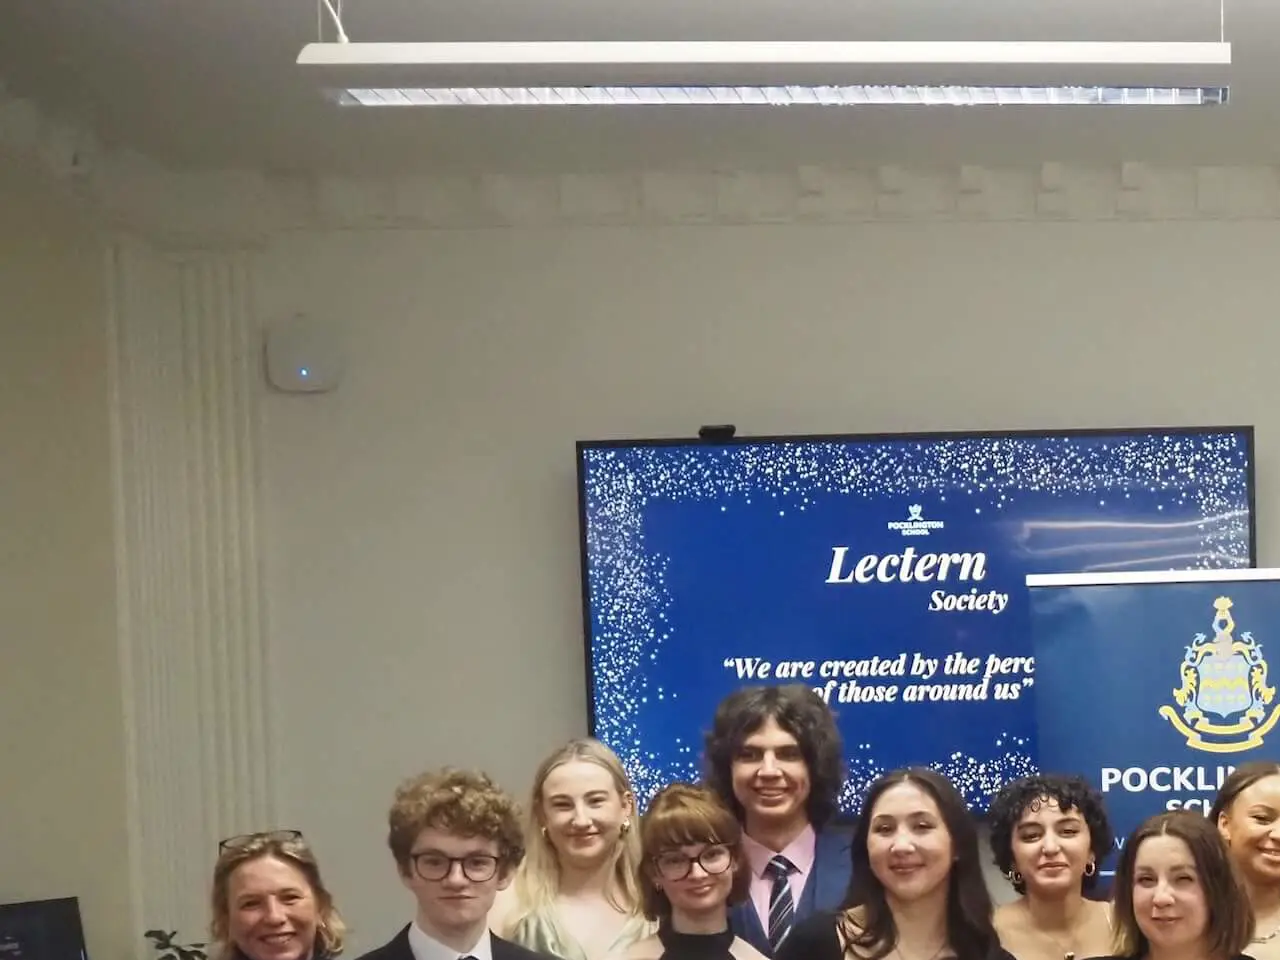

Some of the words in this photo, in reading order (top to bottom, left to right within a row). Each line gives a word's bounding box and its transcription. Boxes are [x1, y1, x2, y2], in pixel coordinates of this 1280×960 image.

[888, 521, 944, 530] POCKLINGTON
[825, 547, 986, 583] Lectern
[928, 588, 1008, 614] Society
[775, 658, 814, 678] are
[819, 653, 905, 678] created
[911, 653, 938, 679] by
[943, 651, 979, 674] the
[838, 681, 899, 703] those
[902, 678, 988, 701] around
